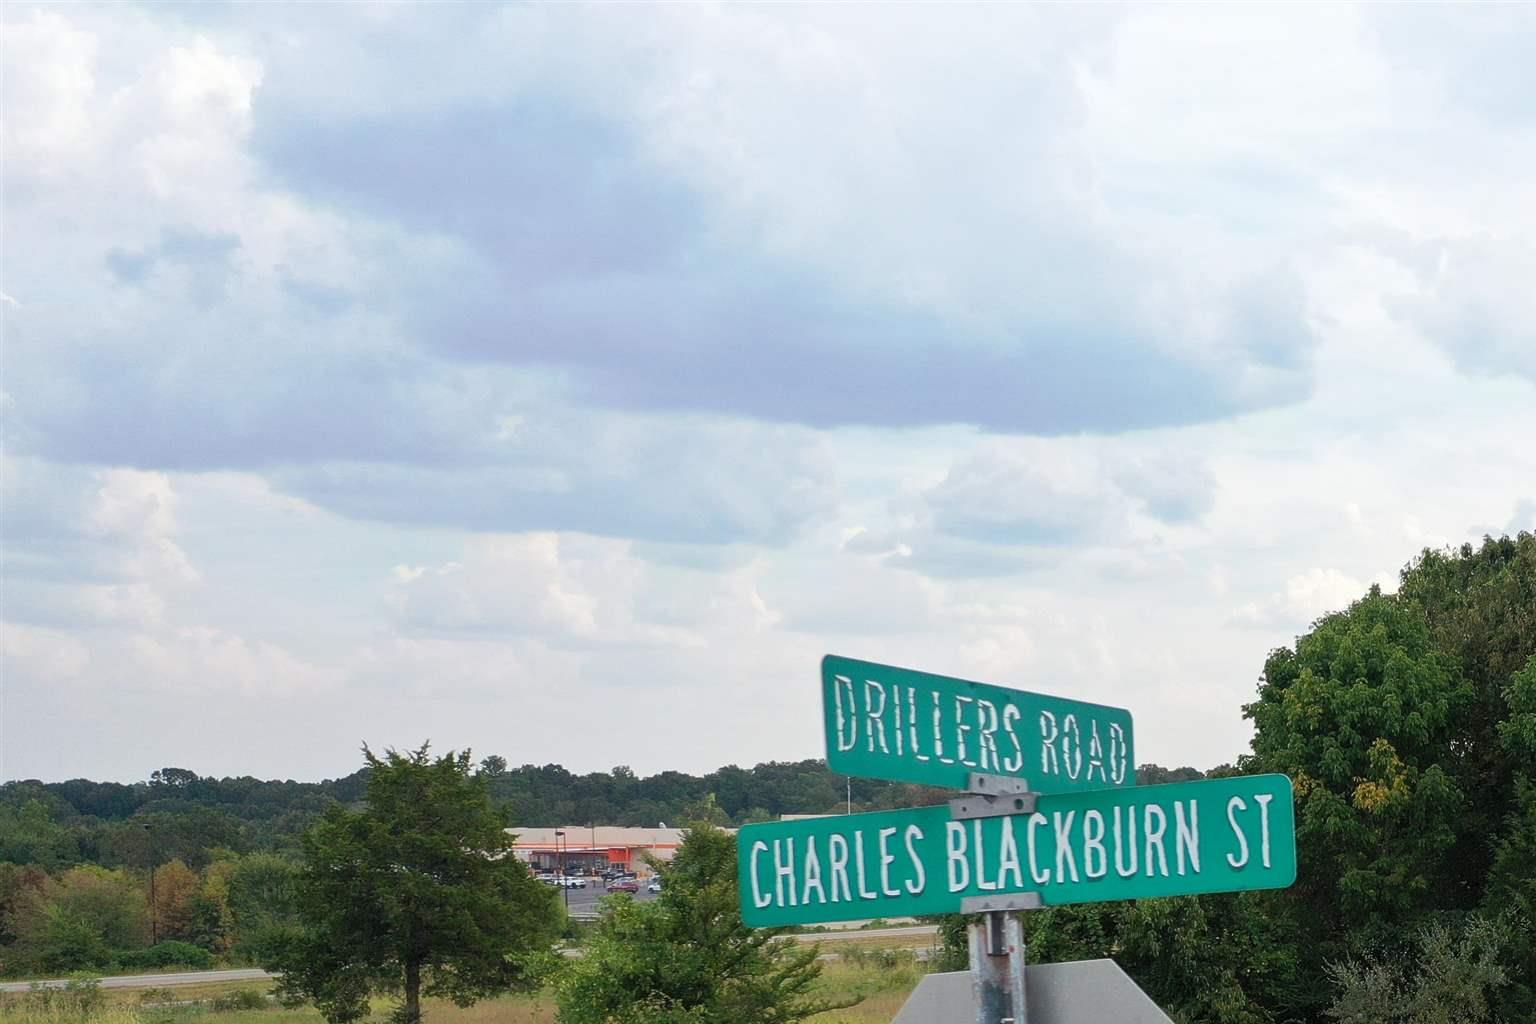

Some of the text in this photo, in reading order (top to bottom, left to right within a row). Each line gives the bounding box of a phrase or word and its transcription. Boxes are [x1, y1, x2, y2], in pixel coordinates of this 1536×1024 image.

[834, 674, 1128, 785] DRILLERS ROAD
[750, 793, 1274, 908] CHARLES BLACKBURN ST
